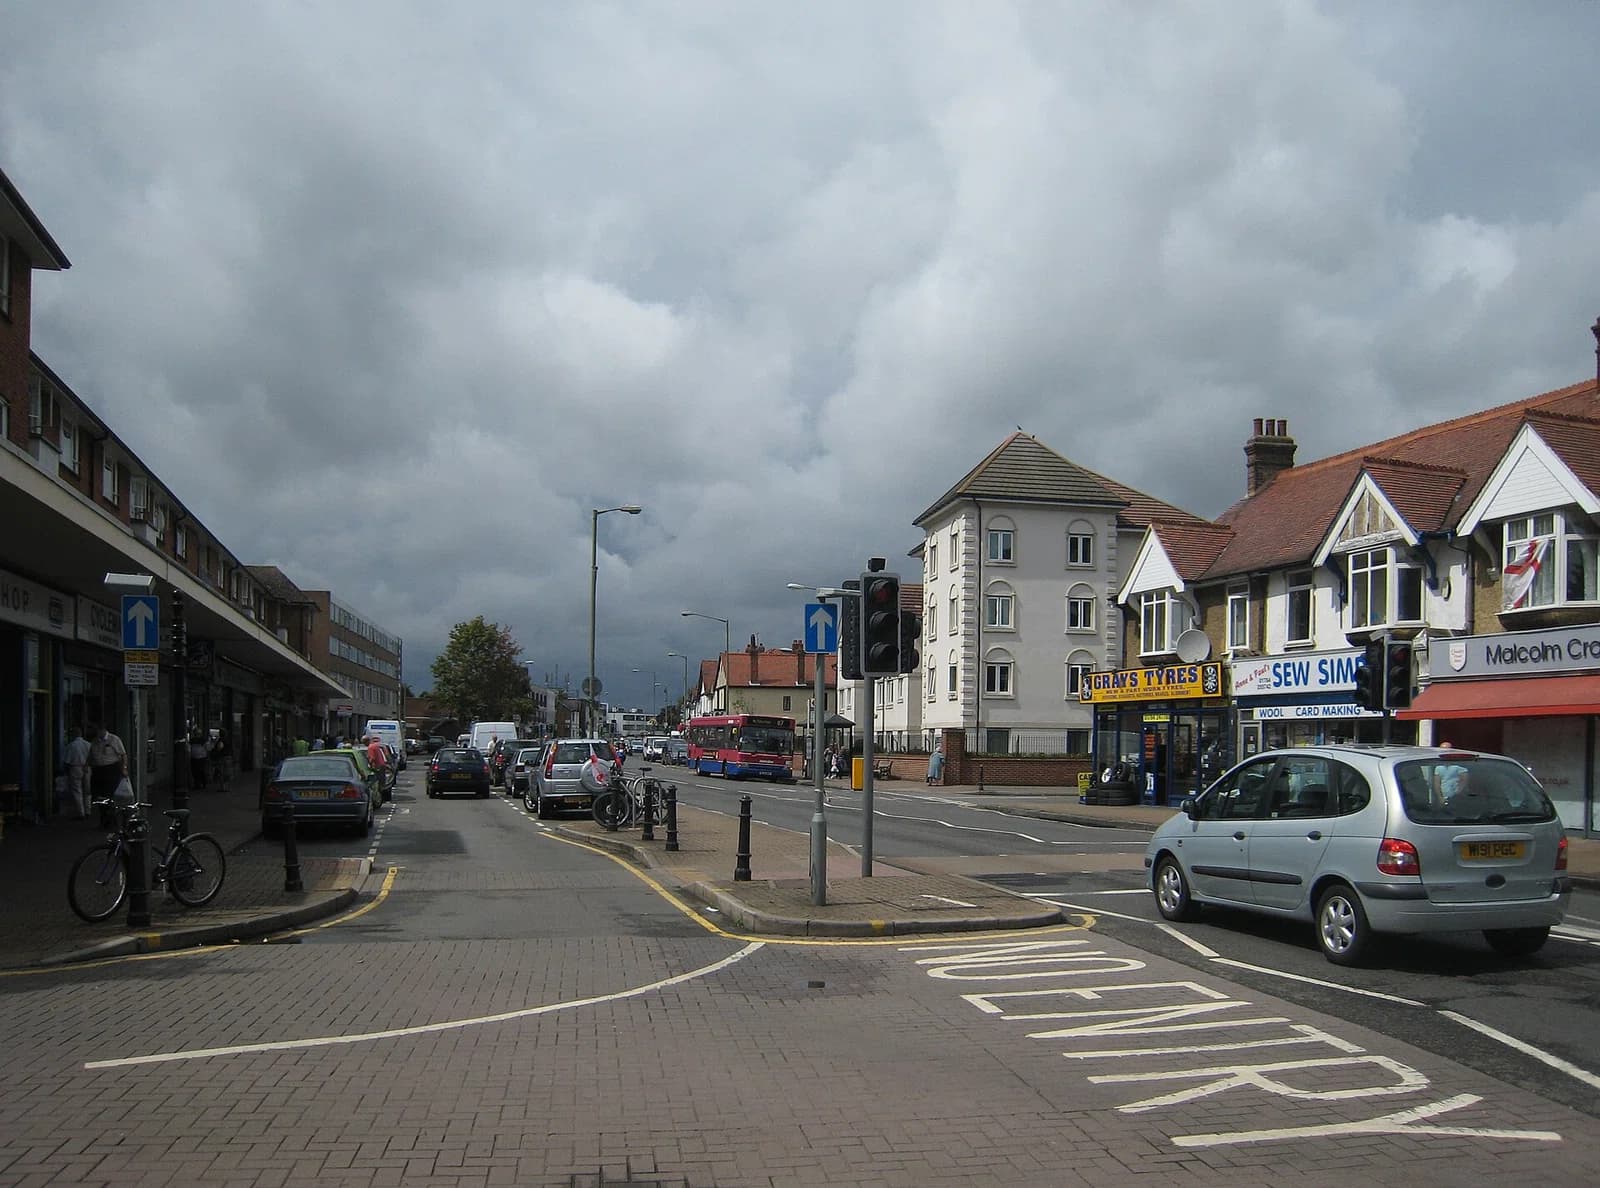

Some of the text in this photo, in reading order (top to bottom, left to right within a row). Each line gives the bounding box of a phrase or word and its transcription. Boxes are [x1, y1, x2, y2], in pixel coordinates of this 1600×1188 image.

[1486, 641, 1562, 666] Malcolm
[1567, 638, 1600, 661] Cro
[1094, 666, 1198, 689] GRAYS TYRES
[1272, 661, 1310, 687] SEW
[1260, 708, 1284, 718] WOOL
[1296, 706, 1319, 717] CARD
[1322, 705, 1361, 716] MAKING
[1493, 843, 1516, 857] PGC
[898, 940, 1147, 980] NO
[960, 981, 1563, 1148] ENTRY
